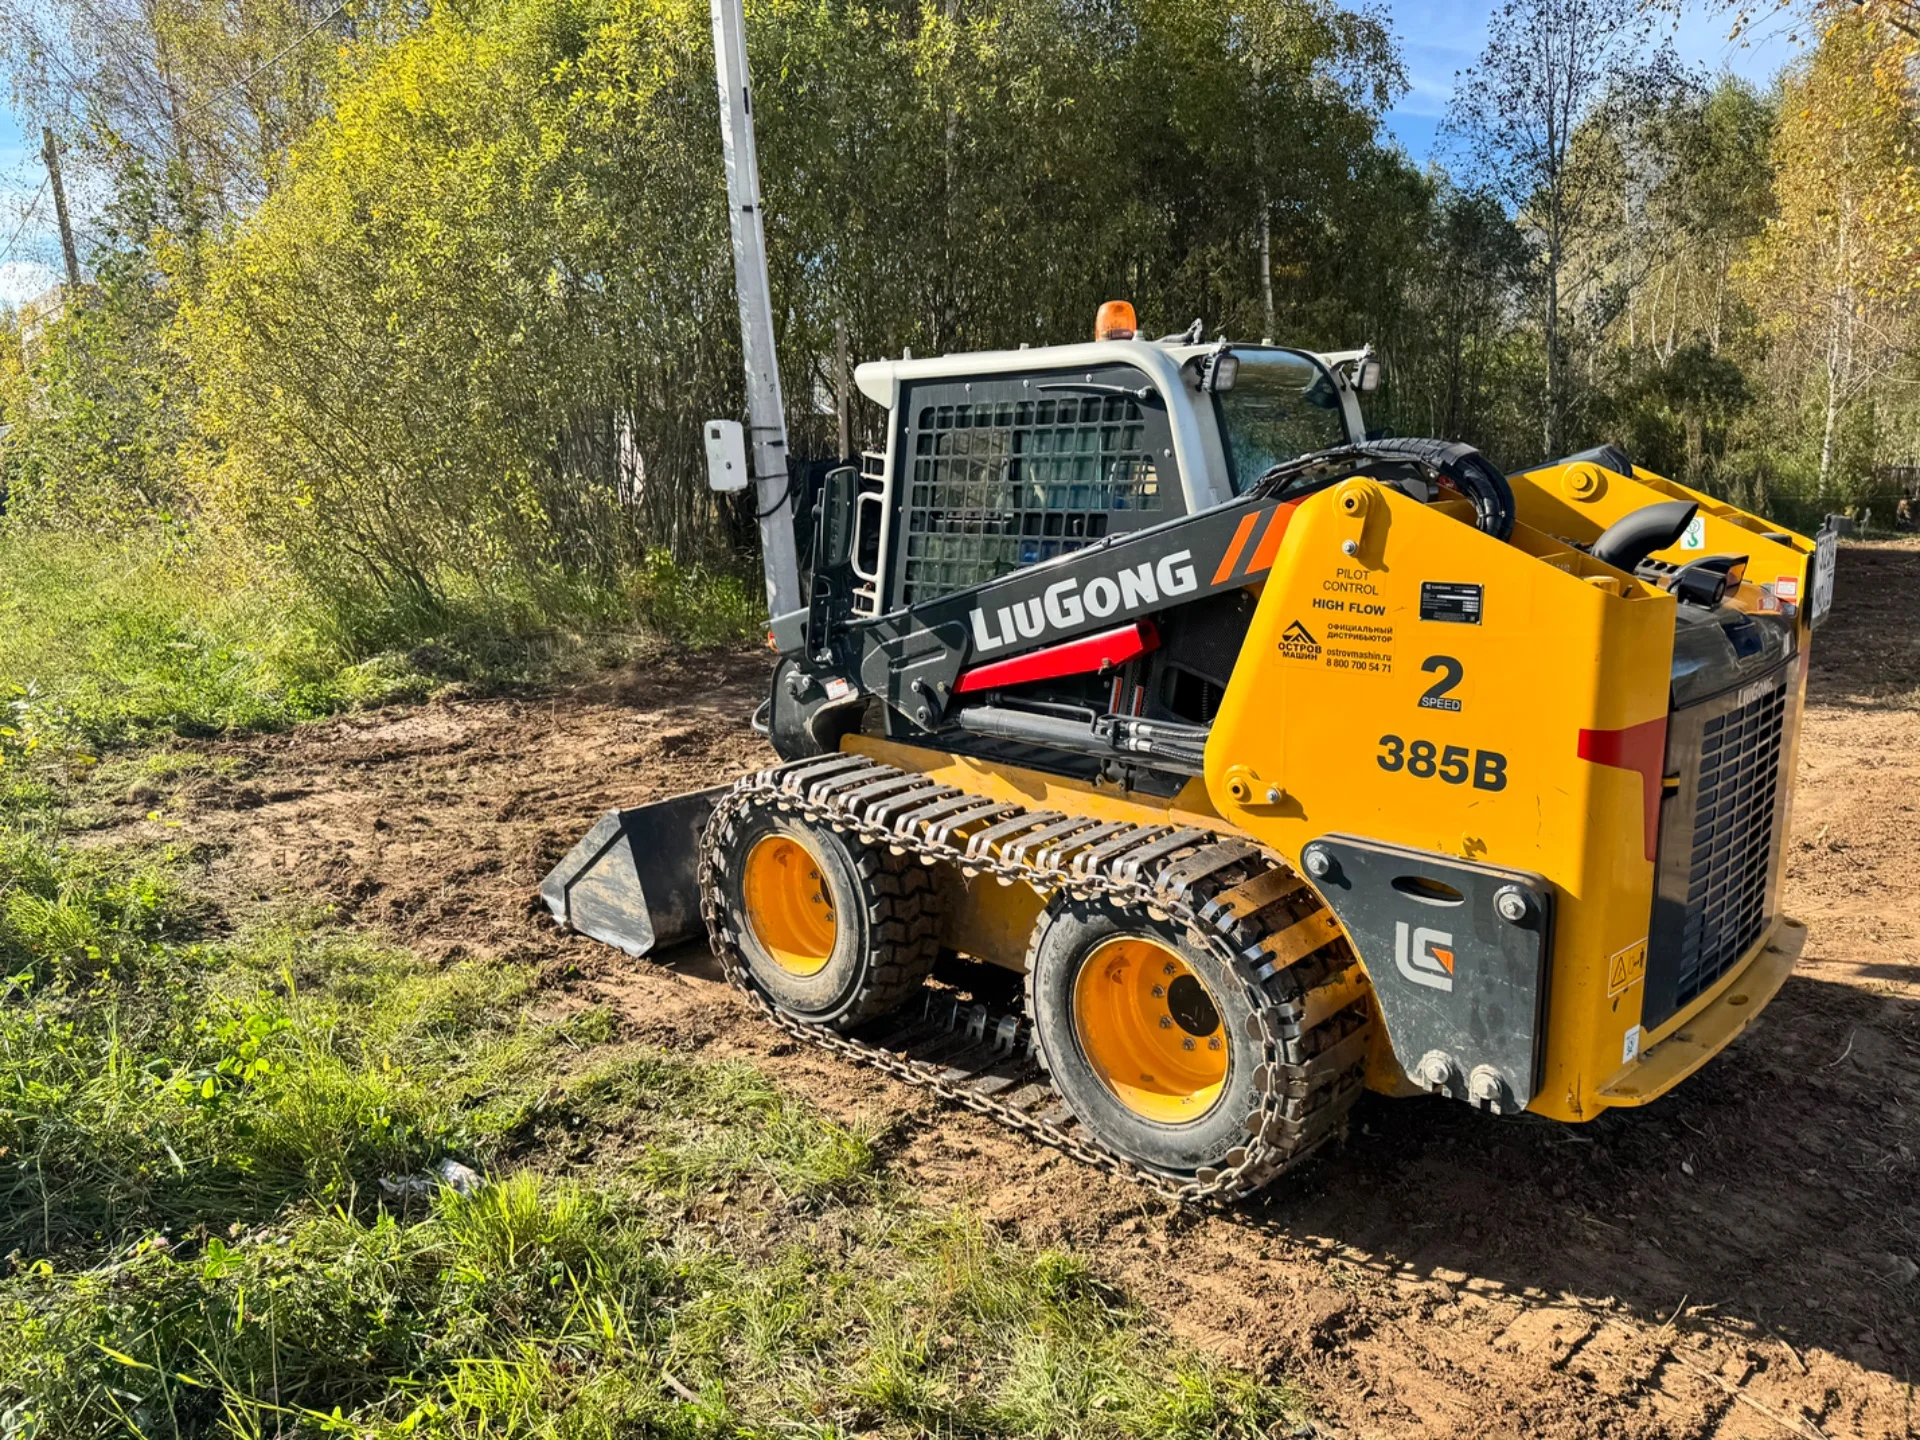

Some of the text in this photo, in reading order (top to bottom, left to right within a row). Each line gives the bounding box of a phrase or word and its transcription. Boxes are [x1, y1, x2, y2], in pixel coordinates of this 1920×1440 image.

[1336, 568, 1370, 580] PILOT
[1323, 580, 1378, 596] CONTROL
[1312, 598, 1386, 616] HIGH FLOW
[1327, 623, 1393, 634] ОФИЦИАЛЬНЫЙ
[1326, 631, 1392, 643] ДИСТРИБЬЮТОР
[1278, 642, 1322, 654] ОСТРОВ
[1326, 648, 1392, 661] ostrovmashin.ru
[1282, 651, 1318, 661] МАШИН
[1326, 658, 1391, 673] 8 800 700 54 71
[1417, 654, 1464, 713] 2
[1421, 696, 1461, 711] SPEED
[1376, 733, 1508, 793] 385B
